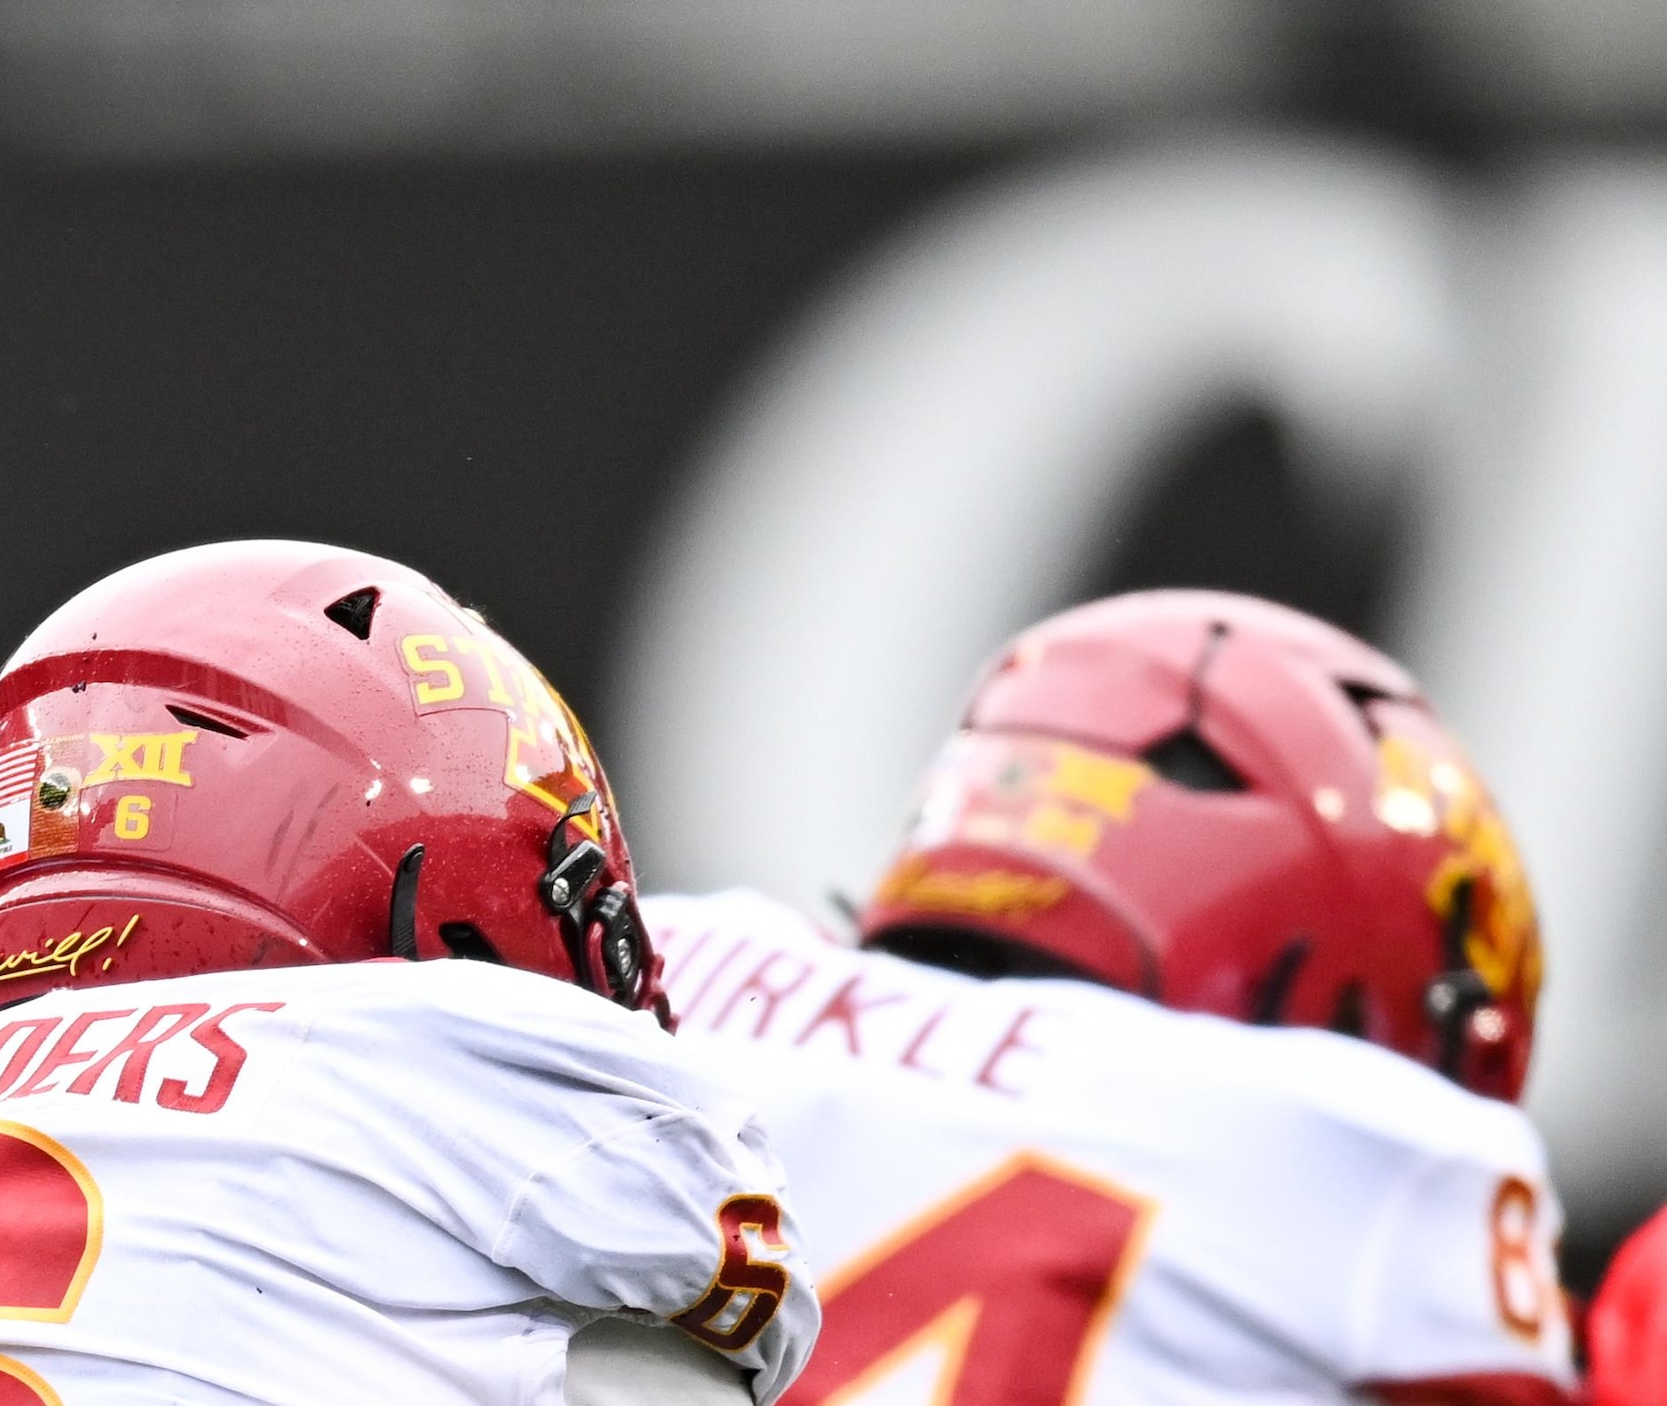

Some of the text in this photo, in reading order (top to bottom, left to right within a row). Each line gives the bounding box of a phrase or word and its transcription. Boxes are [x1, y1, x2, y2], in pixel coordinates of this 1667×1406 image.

[82, 731, 198, 788] XII
[114, 795, 152, 840] 6
[659, 910, 1049, 1099] URKLE
[670, 1193, 790, 1351] 6
